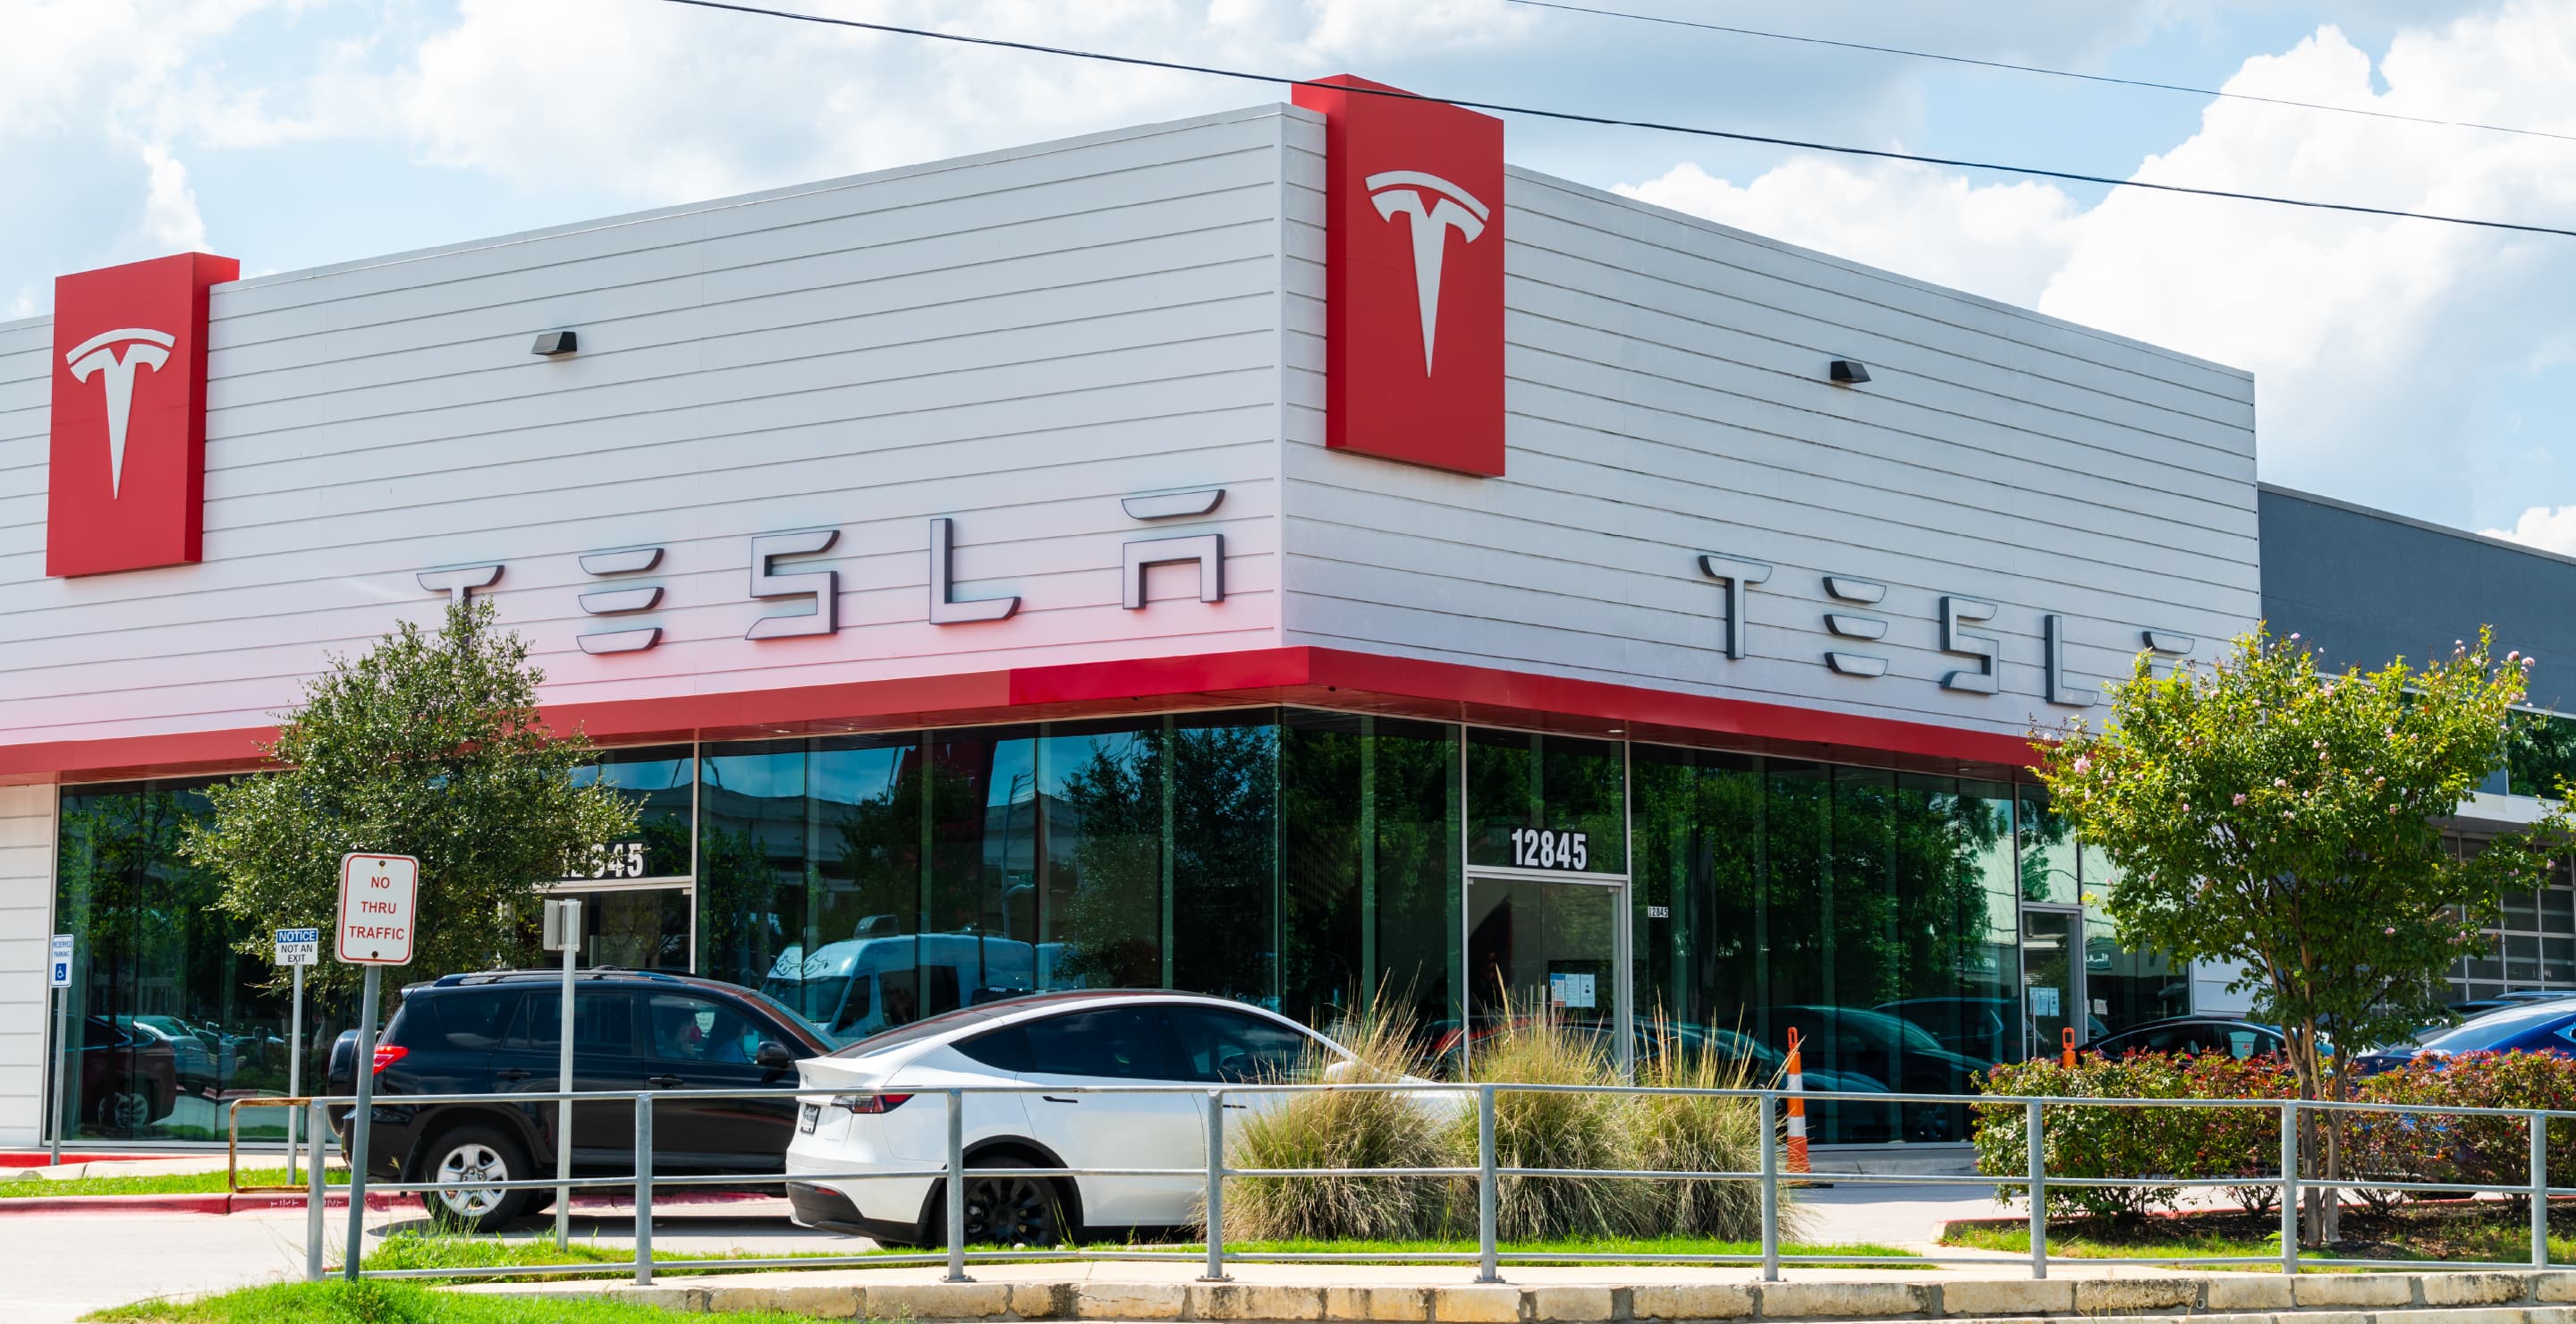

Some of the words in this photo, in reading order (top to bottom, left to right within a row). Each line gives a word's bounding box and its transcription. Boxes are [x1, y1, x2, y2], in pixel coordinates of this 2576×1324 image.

[417, 489, 1224, 660] TESLA
[1511, 828, 1588, 870] 12845
[370, 876, 391, 889] NO
[360, 901, 397, 914] THRU
[1648, 907, 1668, 917] 12845
[278, 930, 316, 942] NOTICE
[349, 925, 405, 940] TRAFFIC
[281, 944, 299, 953] NOT
[301, 944, 313, 953] AN
[287, 954, 306, 963] EXIT
